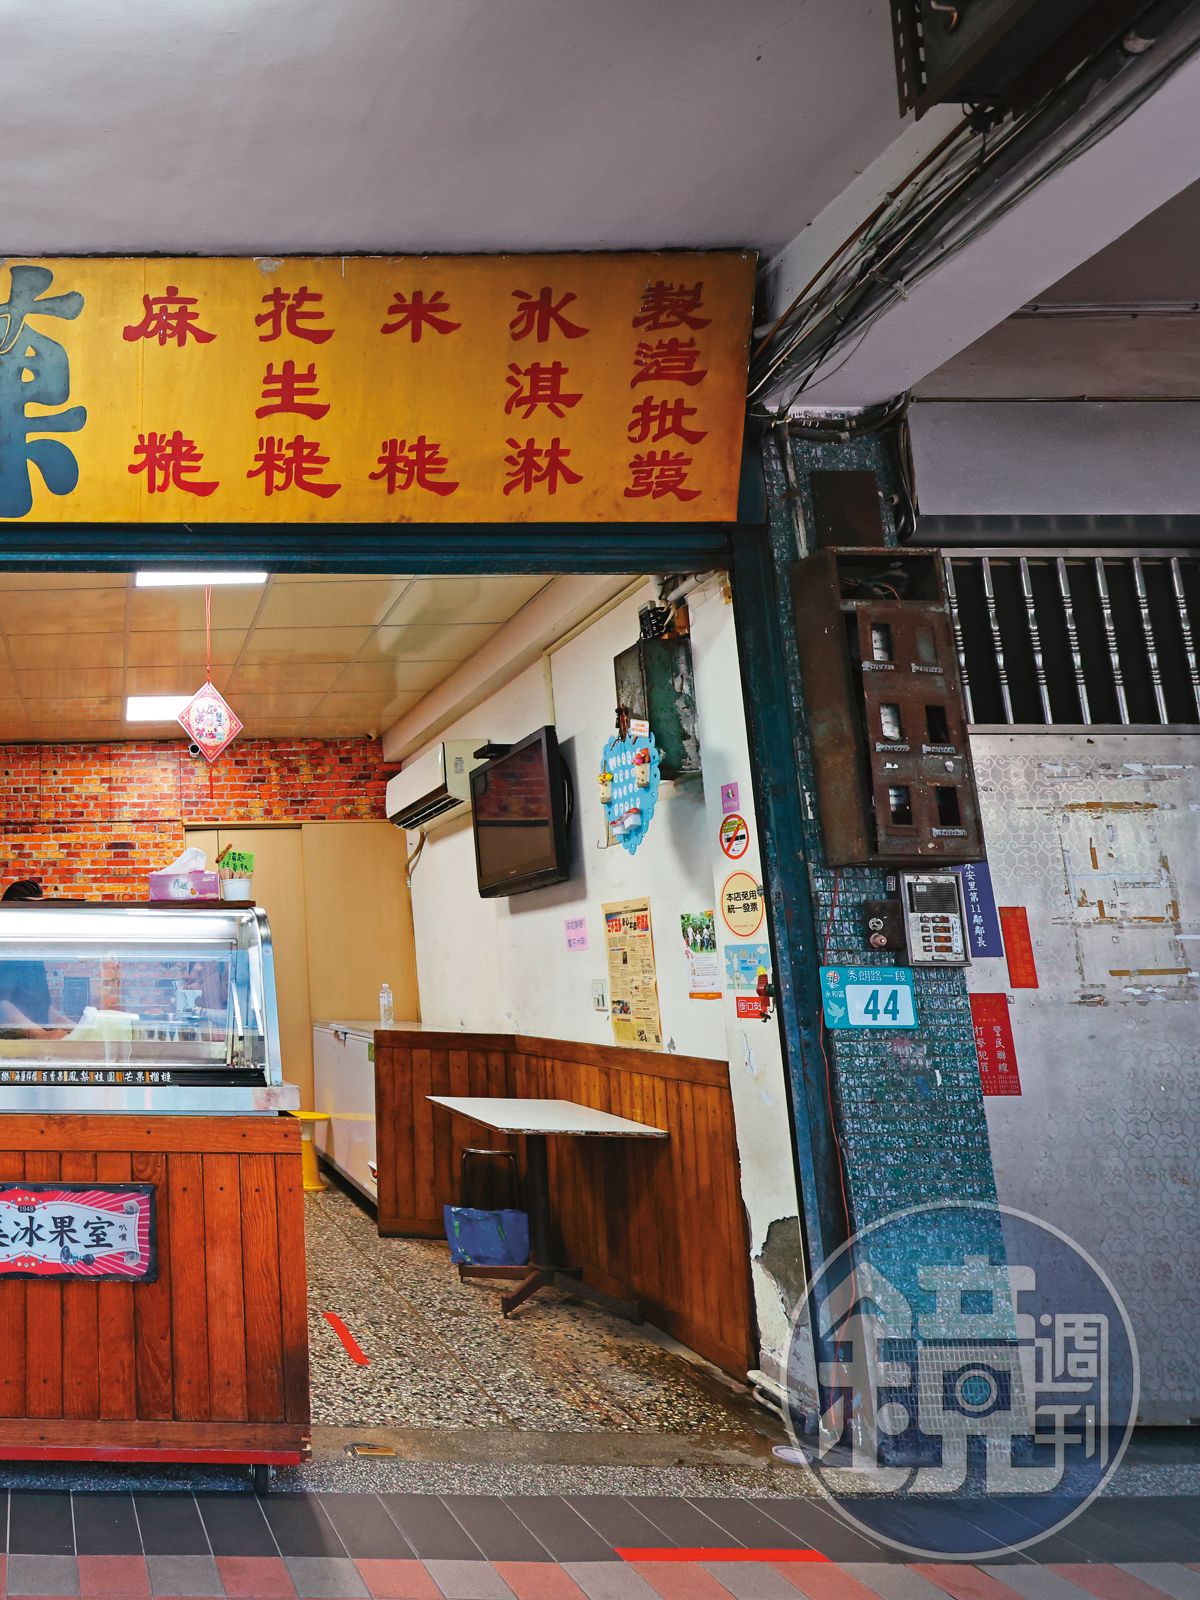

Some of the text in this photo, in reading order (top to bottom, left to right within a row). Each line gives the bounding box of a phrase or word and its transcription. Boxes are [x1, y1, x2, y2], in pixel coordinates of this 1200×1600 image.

[502, 286, 590, 497] 冰淇淋
[623, 279, 712, 502] 製造批發
[726, 889, 758, 903] 本店免用
[727, 902, 759, 914] 統一發票
[847, 969, 907, 983] 秀朗路一段
[825, 990, 846, 998] 永和區
[738, 1000, 764, 1012] 街口支
[863, 989, 900, 1021] 44
[42, 1070, 63, 1082] 百香果
[94, 1070, 115, 1082] 桂圓
[125, 1070, 144, 1082] 芒果
